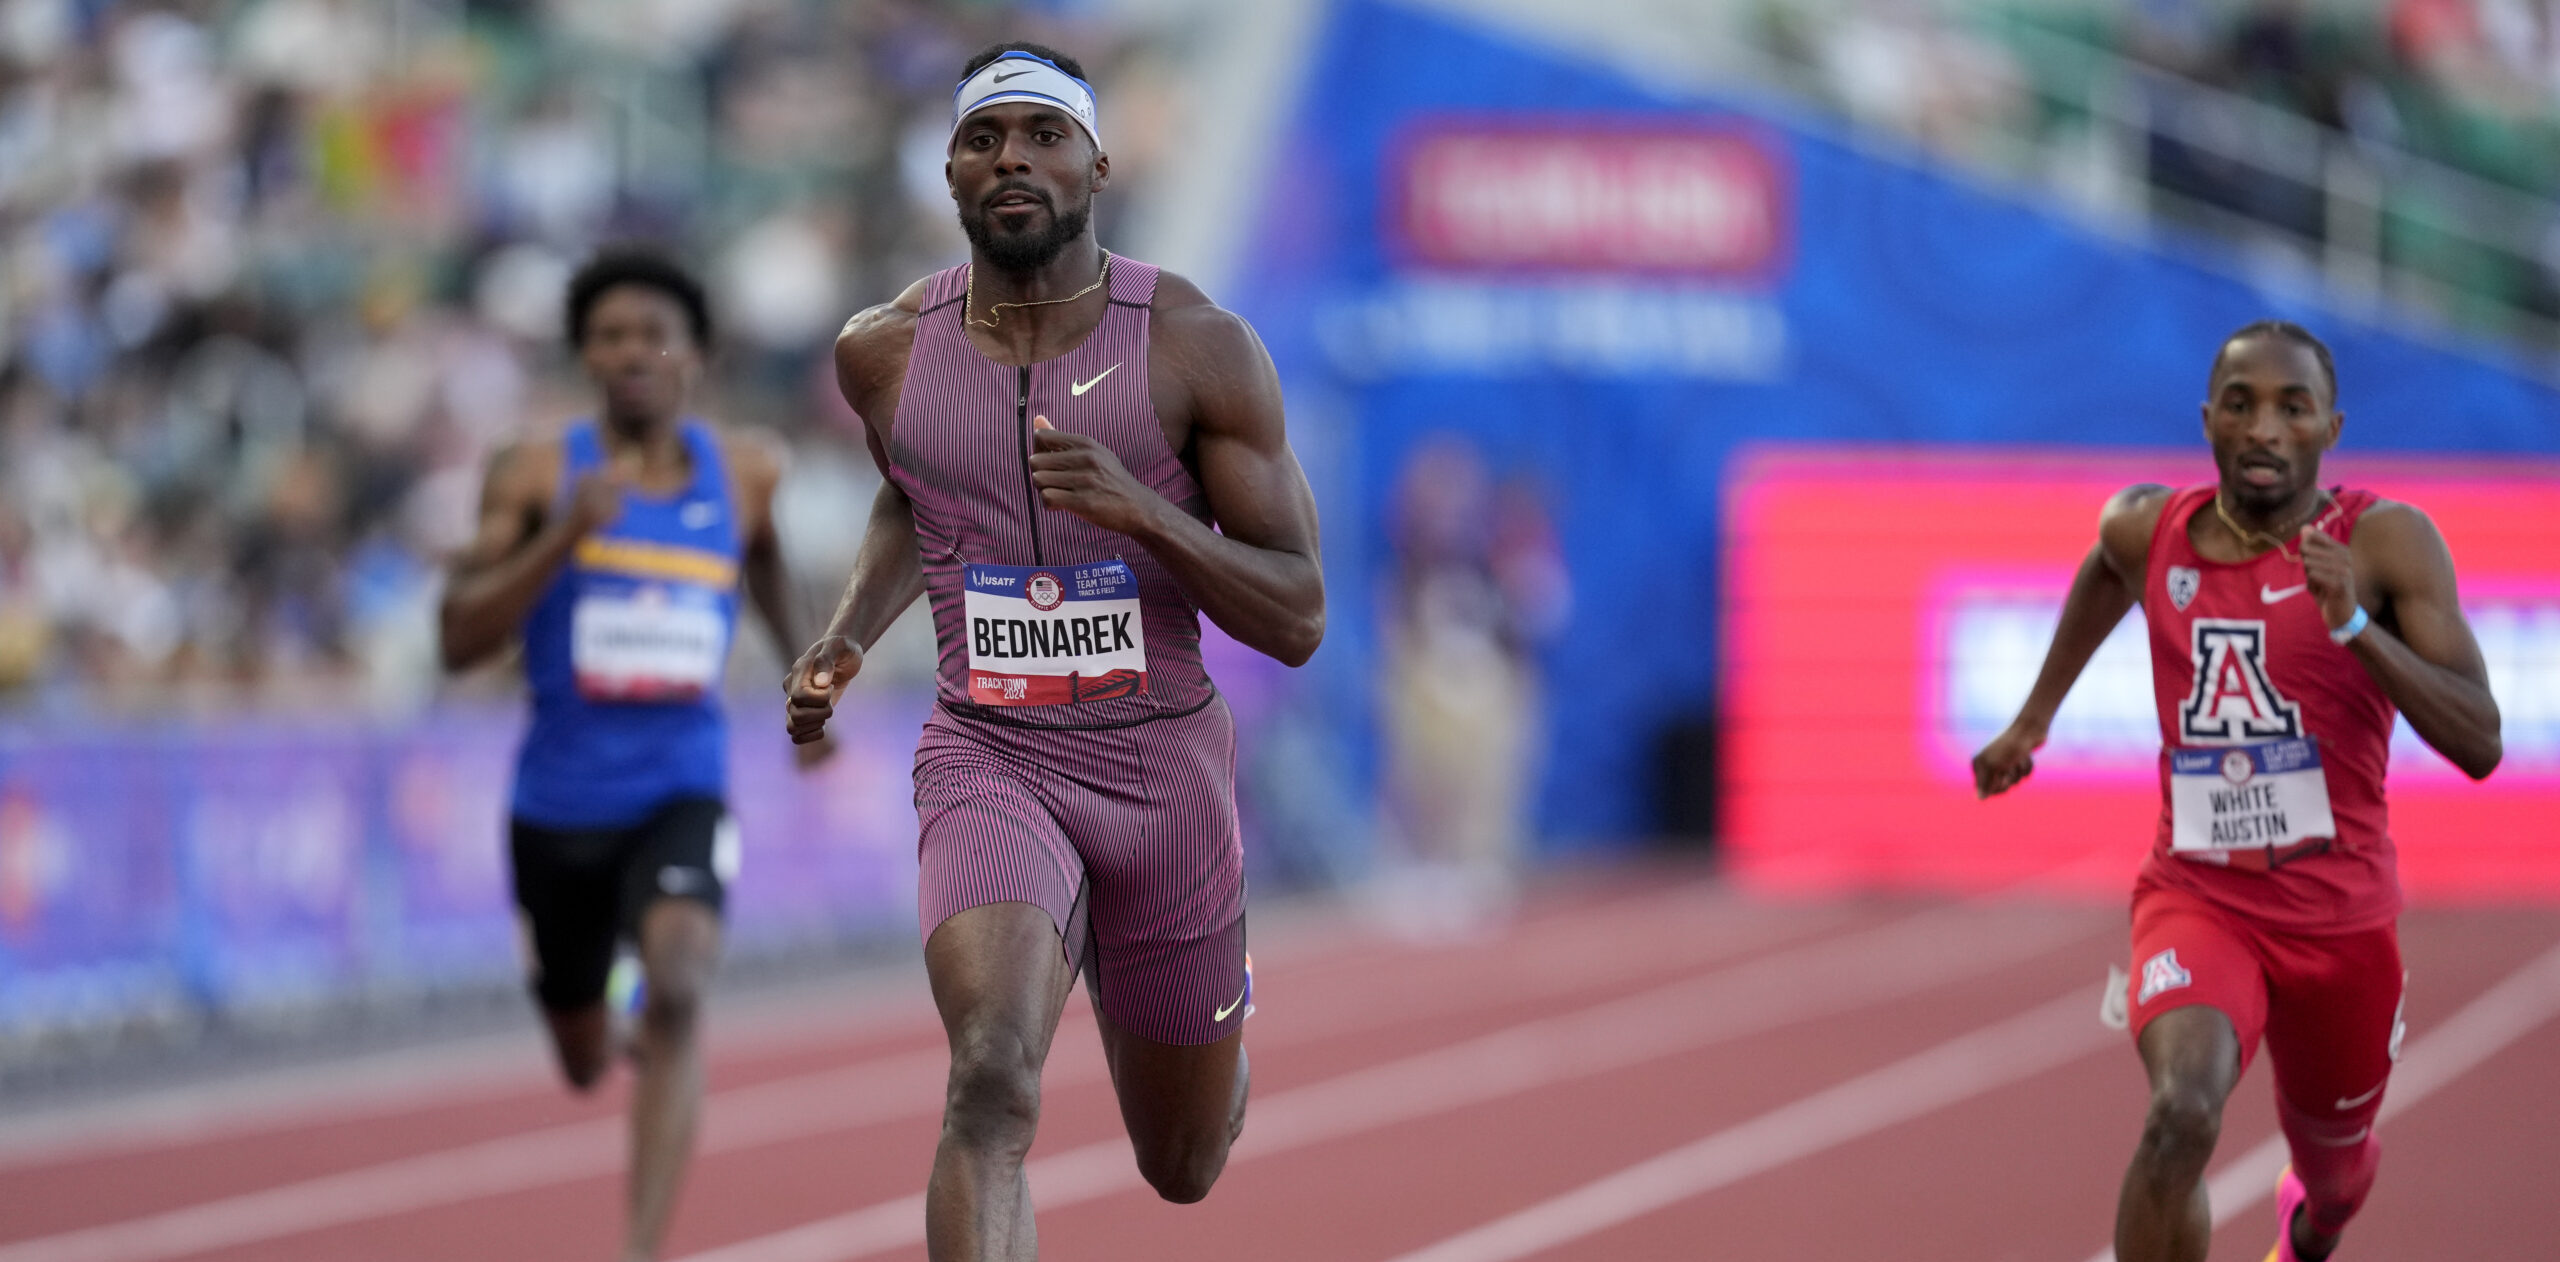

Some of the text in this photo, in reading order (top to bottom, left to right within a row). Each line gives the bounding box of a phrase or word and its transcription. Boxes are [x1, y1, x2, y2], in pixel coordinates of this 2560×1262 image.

[1075, 565, 1125, 579] U.S. OLYMPIC
[985, 576, 1016, 587] USATF
[1076, 575, 1126, 589] TEAM TRIALS
[1078, 589, 1095, 597] TRACK
[1101, 586, 1116, 595] FIELD
[973, 611, 1134, 659] BEDNAREK
[976, 676, 1028, 690] TRACKTOWN
[2178, 617, 2306, 746] A
[1003, 688, 1026, 700] 2024
[2209, 783, 2278, 814] WHITE
[2211, 814, 2288, 844] AUSTIN
[2137, 947, 2192, 1006] A
